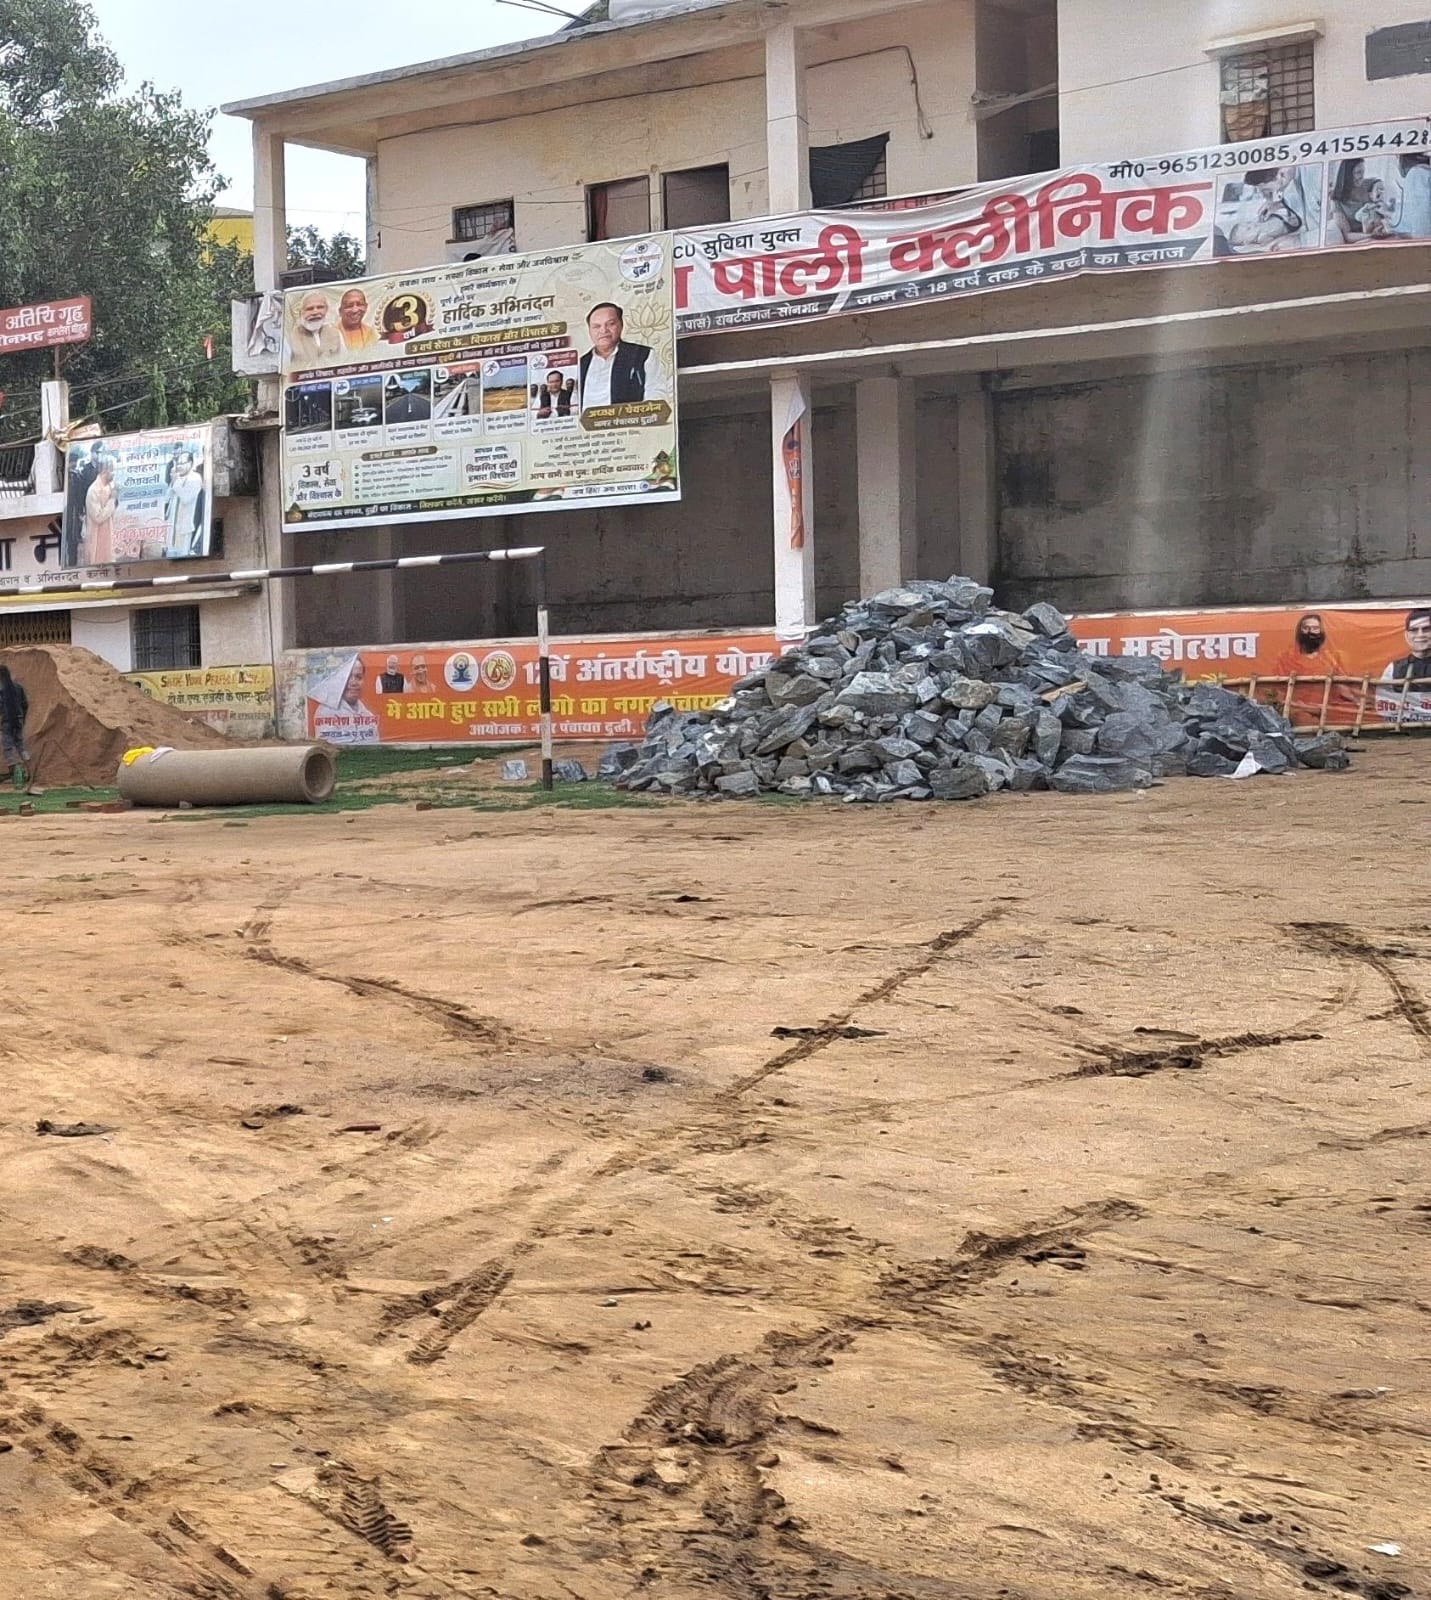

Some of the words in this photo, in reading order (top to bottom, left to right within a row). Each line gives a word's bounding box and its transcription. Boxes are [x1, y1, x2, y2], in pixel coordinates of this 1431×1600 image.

[1109, 129, 1431, 179] मो0-9651230085,941554428
[703, 234, 753, 260] सुविधा
[760, 228, 801, 250] युक्त
[711, 224, 868, 299] पाली
[887, 173, 1213, 273] क्लीनिक
[856, 289, 896, 305] जन्म
[902, 283, 920, 297] से
[928, 282, 947, 293] 18
[953, 269, 981, 288] वर्ष
[986, 267, 1020, 282] तक
[1026, 260, 1044, 277] के
[1093, 252, 1120, 265] का
[1127, 246, 1186, 265] इलाज
[6, 306, 56, 329] अतिथि
[58, 305, 84, 326] गृह
[393, 294, 419, 331] 3
[442, 299, 485, 324] हार्दिक
[488, 294, 555, 316] अभिनंदन
[0, 331, 45, 346] ोनभद्र
[302, 465, 310, 477] 3
[314, 461, 329, 475] वर्ष
[0, 575, 19, 586] ागत
[37, 570, 80, 583] अभिनन्दन
[1120, 628, 1259, 661] महोत्सव
[407, 698, 446, 719] आये
[451, 701, 477, 724] हुए
[482, 696, 520, 717] सभी
[580, 698, 608, 715] का
[531, 722, 556, 734] नर
